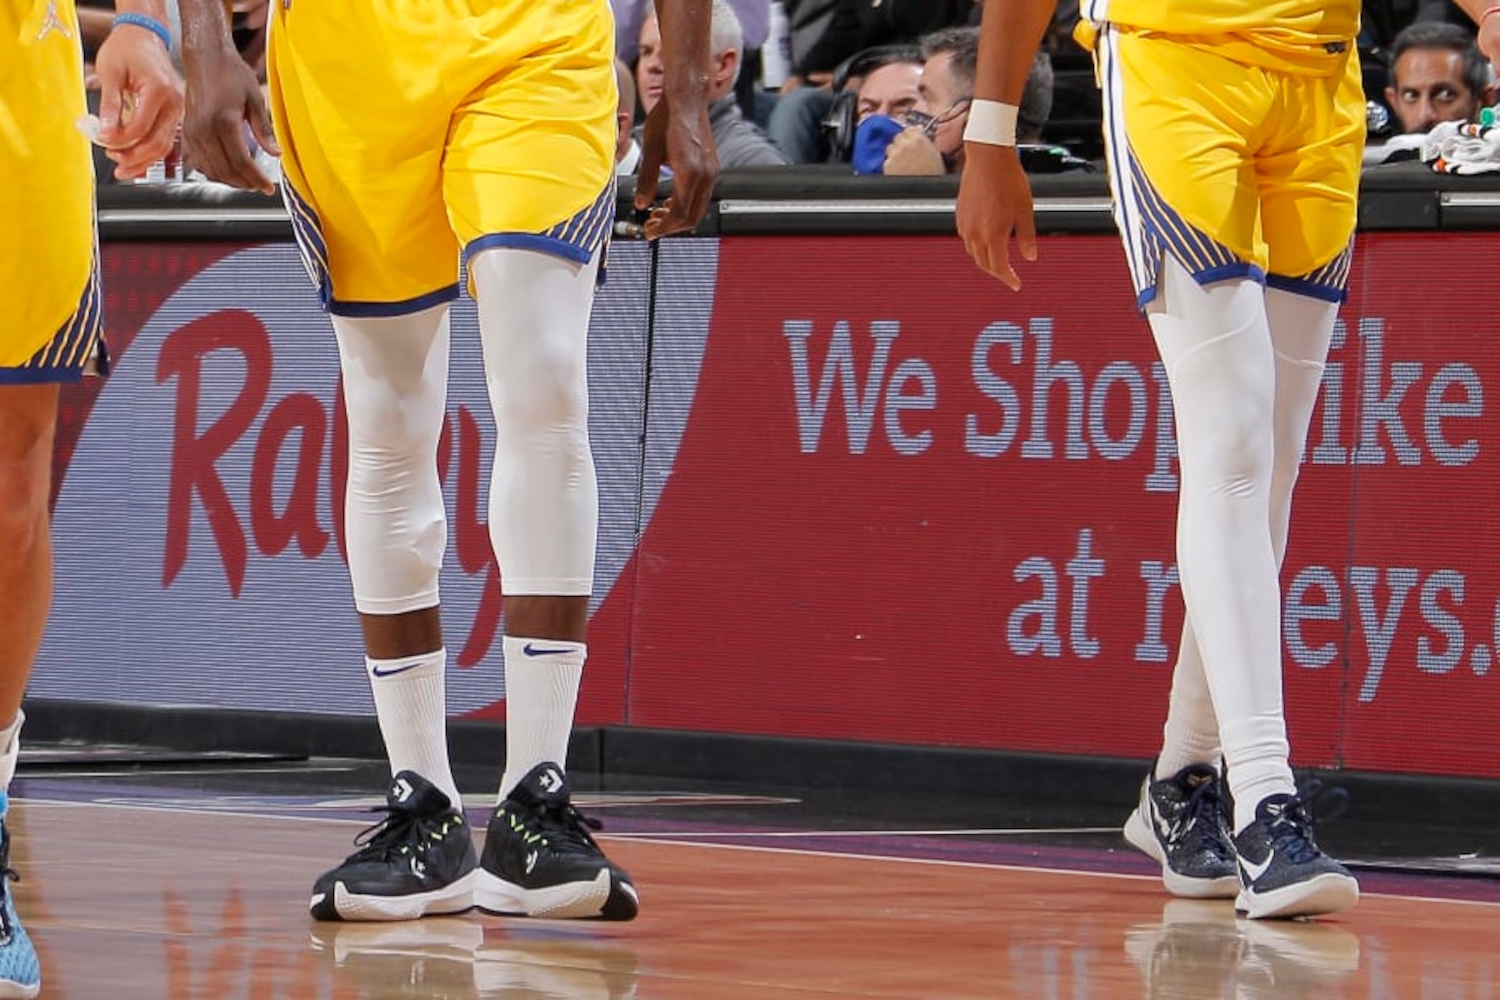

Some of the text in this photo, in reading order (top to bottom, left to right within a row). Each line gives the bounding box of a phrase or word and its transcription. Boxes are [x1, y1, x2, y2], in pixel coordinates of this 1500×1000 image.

[782, 319, 938, 457] We
[1298, 317, 1485, 467] ike
[1006, 527, 1106, 660] at
